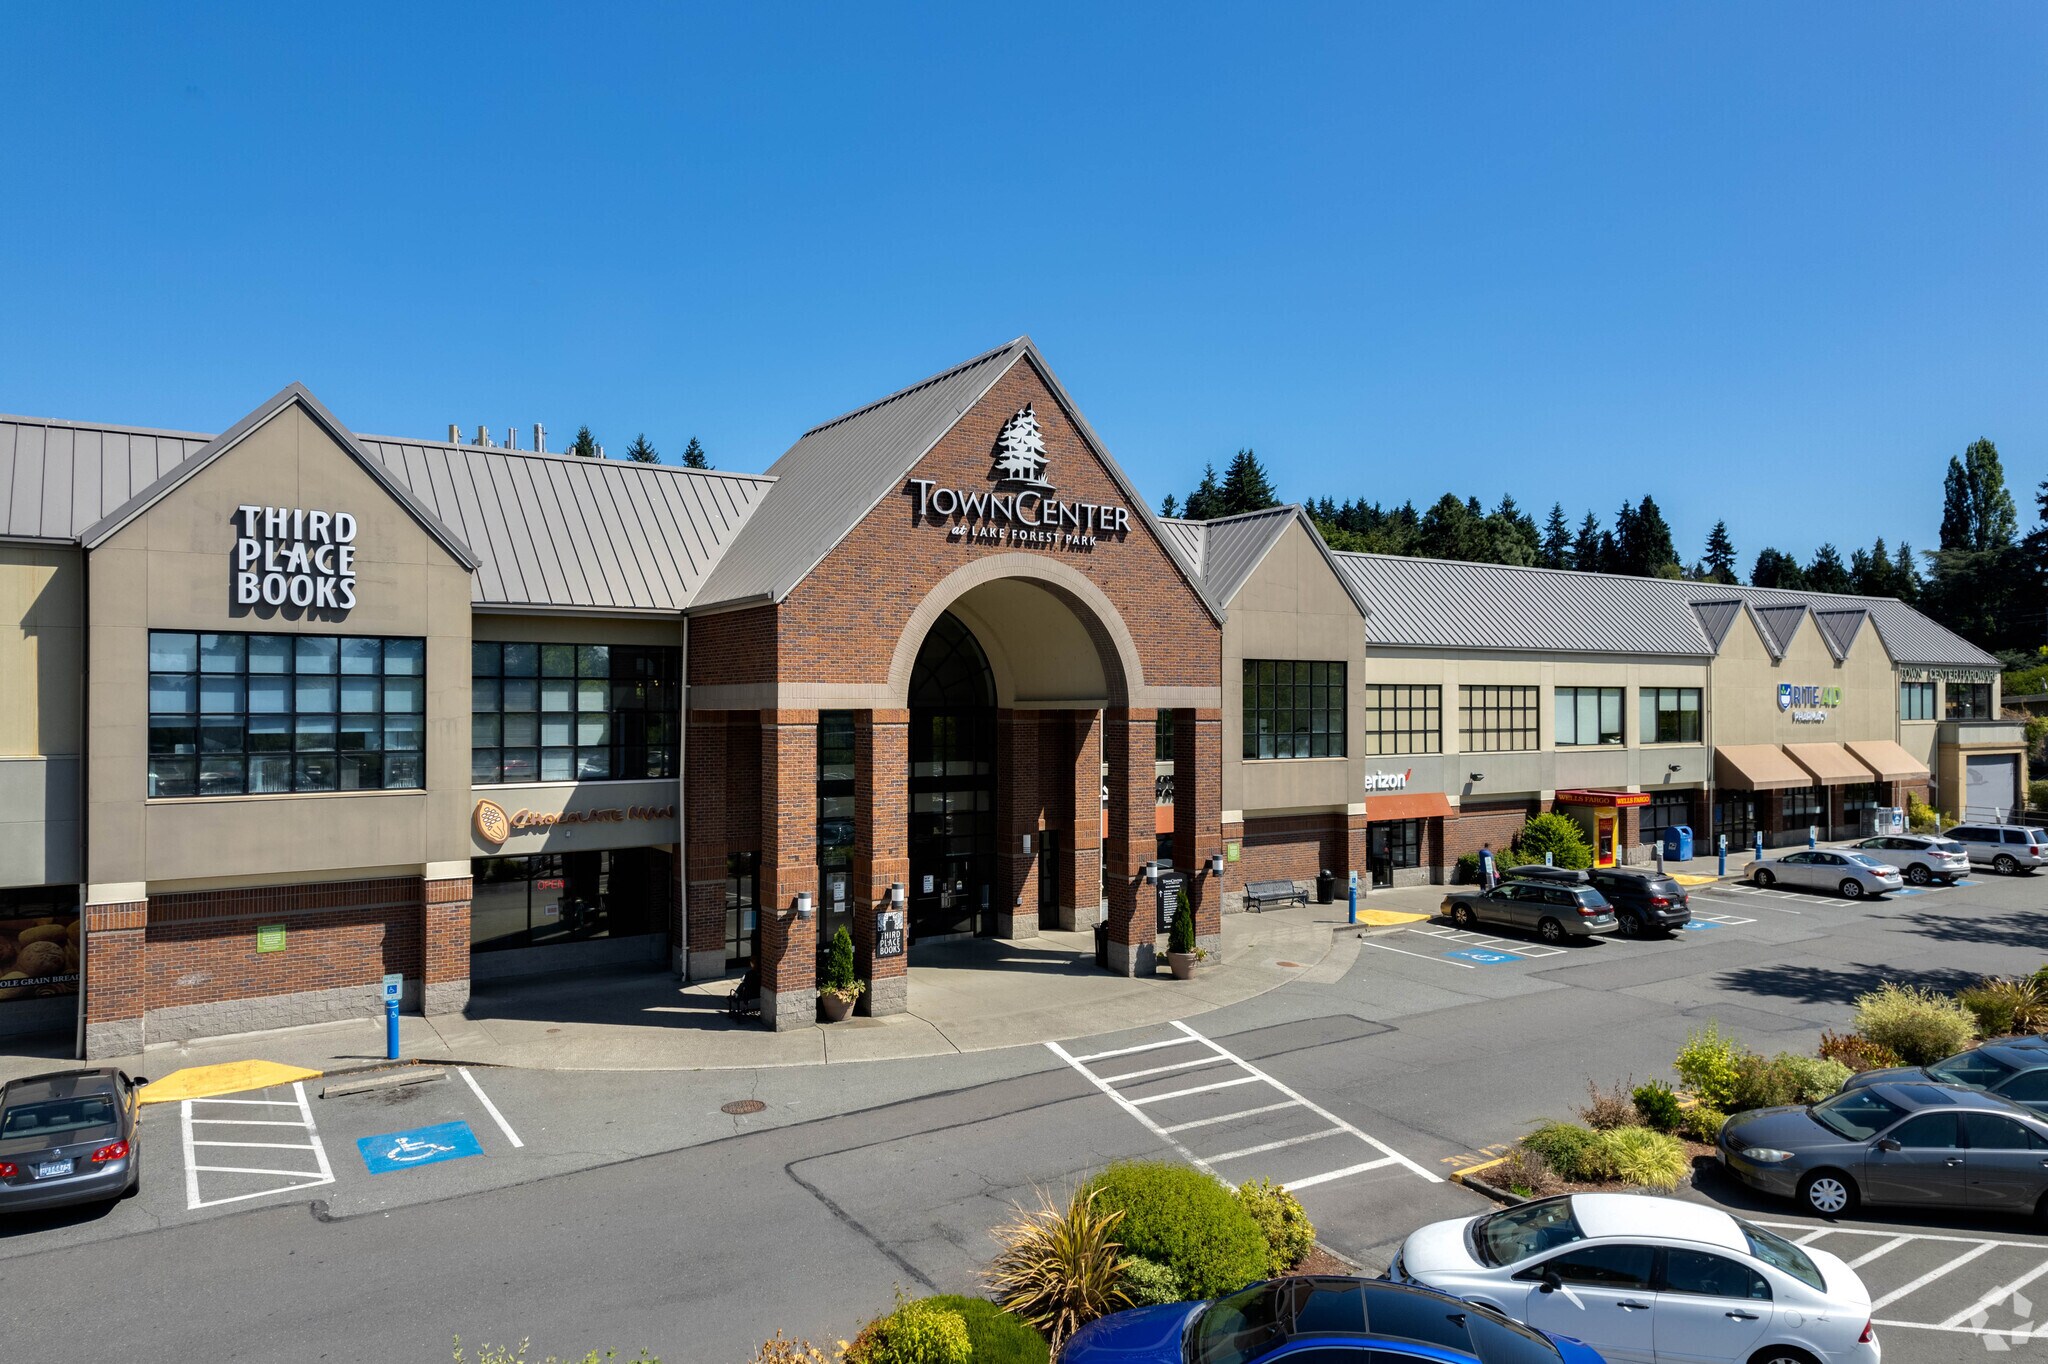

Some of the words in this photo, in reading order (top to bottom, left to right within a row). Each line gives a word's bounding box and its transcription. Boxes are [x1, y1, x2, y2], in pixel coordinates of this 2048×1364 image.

[238, 505, 357, 544] THIRD
[951, 526, 968, 536] at
[971, 526, 1006, 540] LAKE
[1011, 529, 1060, 543] FOREST
[1065, 533, 1097, 546] PARK
[238, 538, 357, 576] PLACE
[237, 572, 357, 609] BOOKS
[1900, 667, 1923, 680] TOWN
[1929, 668, 1959, 680] CENTER
[1959, 669, 1998, 681] HARDWARE
[1793, 686, 1820, 705] RITE
[1821, 687, 1843, 705] AID
[1364, 769, 1406, 790] erizon
[1558, 793, 1584, 803] WELLS
[1616, 797, 1634, 805] WELLS
[537, 879, 565, 890] OPEN
[881, 931, 901, 940] THIRD
[880, 938, 900, 947] PLACE
[880, 946, 901, 955] BOOKS
[0, 980, 20, 988] OLE
[20, 977, 50, 986] GRAIN
